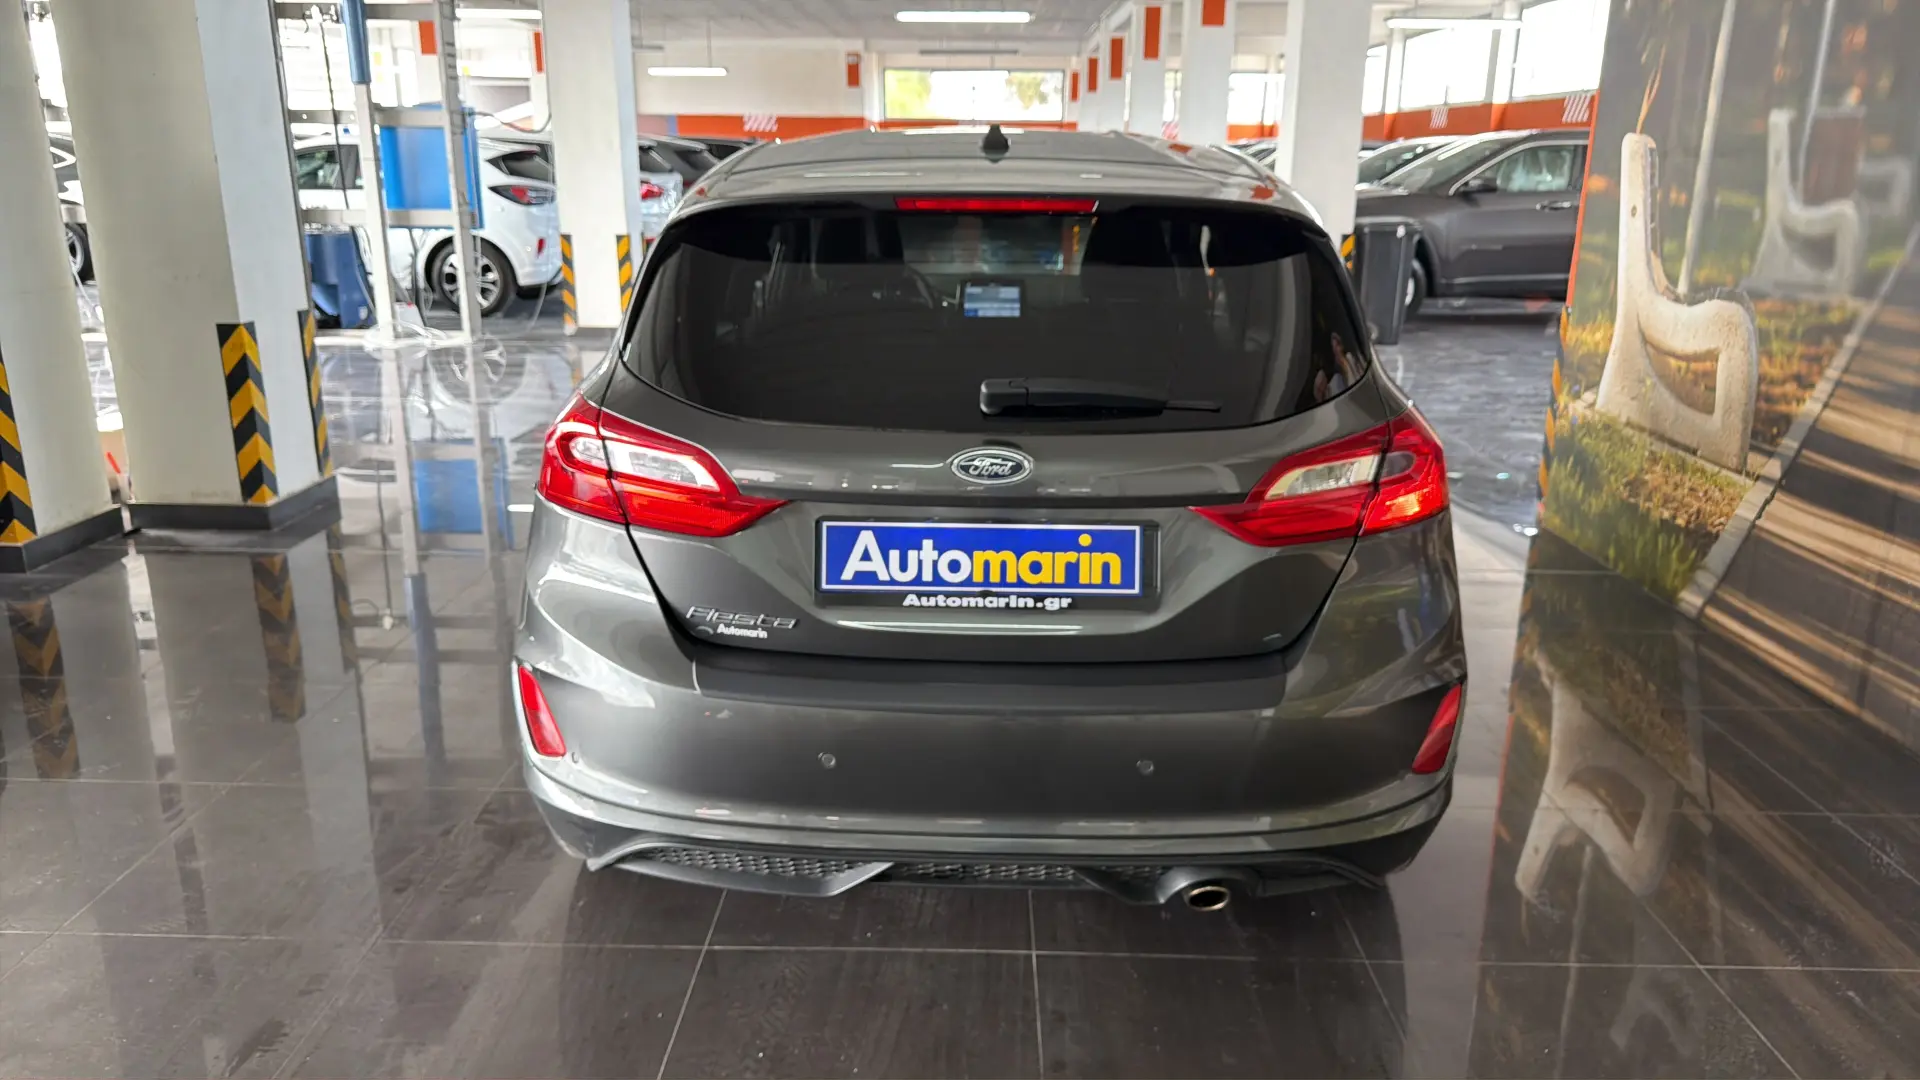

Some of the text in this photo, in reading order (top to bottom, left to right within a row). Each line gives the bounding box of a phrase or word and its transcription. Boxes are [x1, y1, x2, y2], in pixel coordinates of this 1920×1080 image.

[959, 456, 1016, 476] Ford
[840, 530, 1122, 585] Automarin
[902, 593, 1073, 611] Automarin.gr
[685, 606, 797, 629] Fiesta
[716, 623, 768, 639] Automarin
